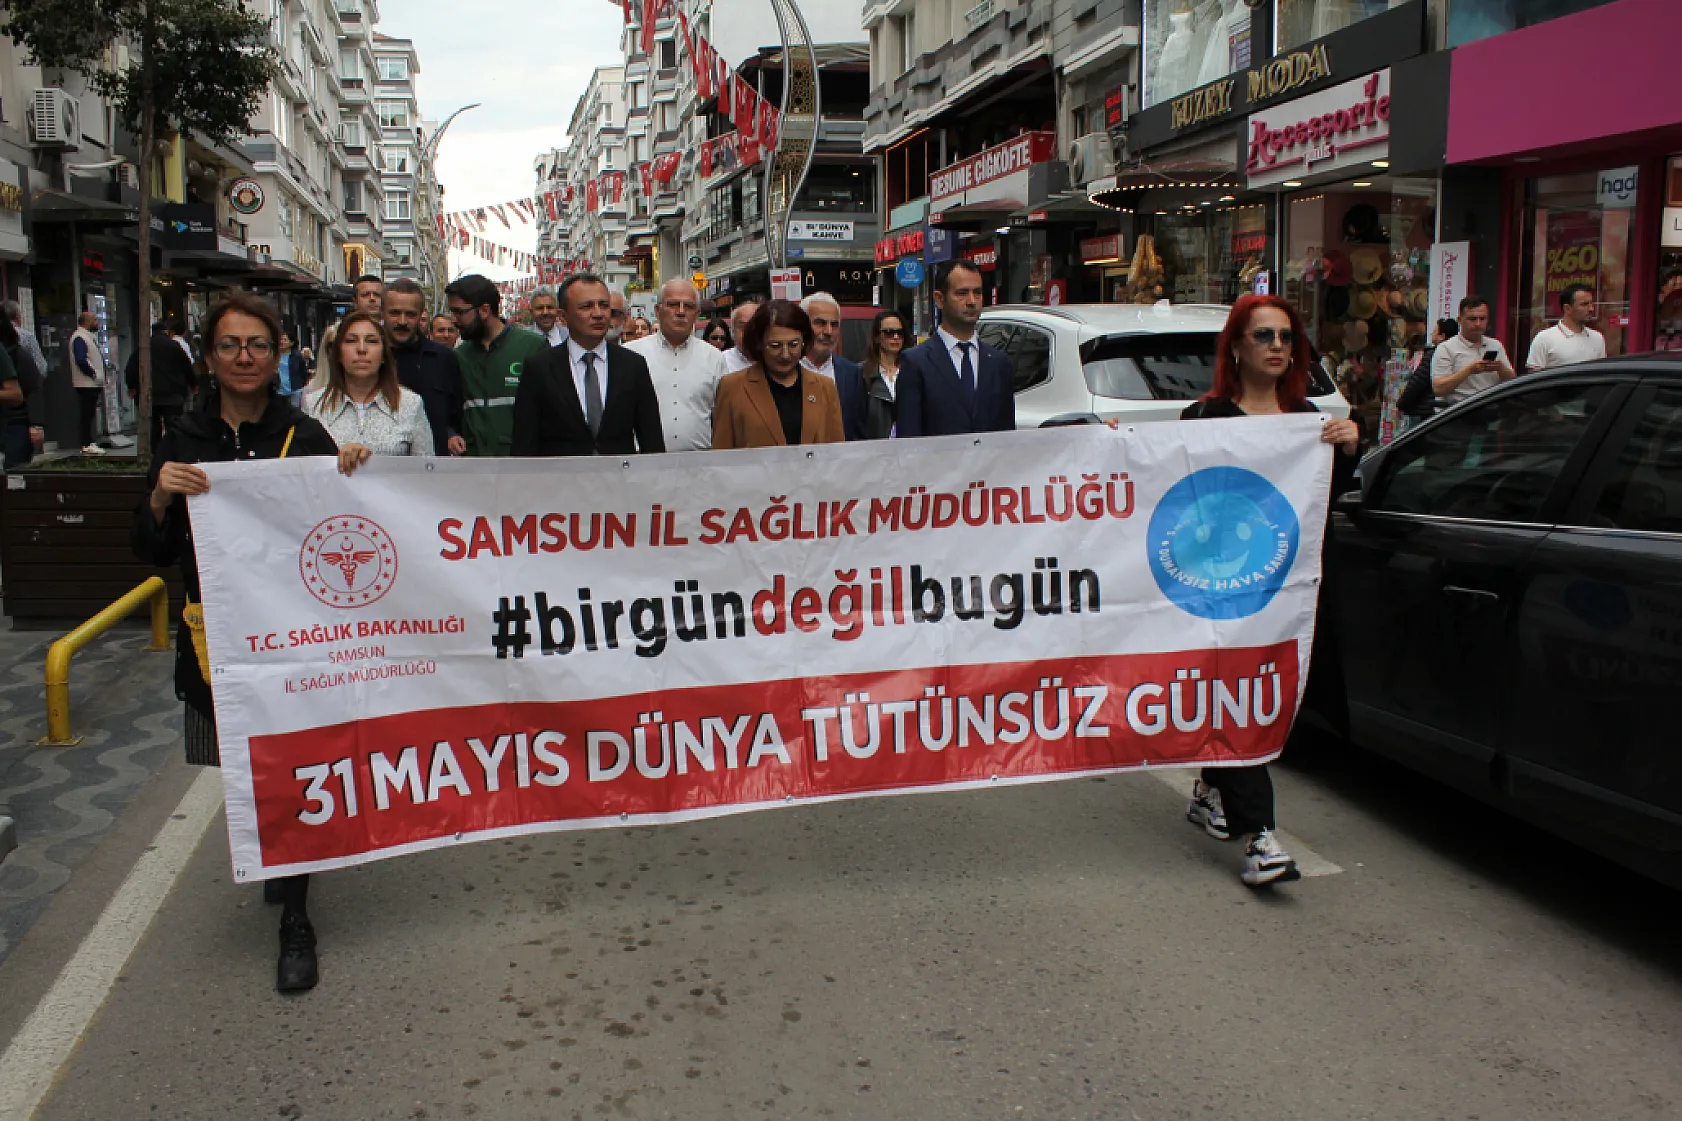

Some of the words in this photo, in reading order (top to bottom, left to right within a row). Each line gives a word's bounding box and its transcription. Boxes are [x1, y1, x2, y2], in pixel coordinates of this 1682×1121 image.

[1170, 80, 1234, 129] KUZEY
[1247, 44, 1331, 104] MODA
[1547, 244, 1598, 274] %60
[437, 512, 637, 561] SAMSUN
[648, 503, 689, 547] İL
[698, 495, 858, 545] SAĞLIK
[867, 472, 1135, 534] MÜDÜRLÜĞÜ
[1215, 572, 1266, 591] HAVA
[492, 557, 1101, 659] #birgündeğilbugün
[246, 633, 284, 653] T.C.
[288, 623, 353, 648] SAĞLIK
[357, 615, 465, 638] BAKANLIĞI
[328, 645, 386, 664] SAMSUN
[284, 678, 297, 694] İL
[300, 671, 346, 692] SAĞLIK
[347, 660, 437, 684] MÜDÜRLÜĞÜ
[294, 756, 358, 826] 31
[368, 731, 571, 811] MAYIS
[586, 711, 792, 783] DÜNYA
[802, 676, 1109, 761] TÜTÜNSÜZ
[1125, 662, 1281, 736] GÜNÜ
